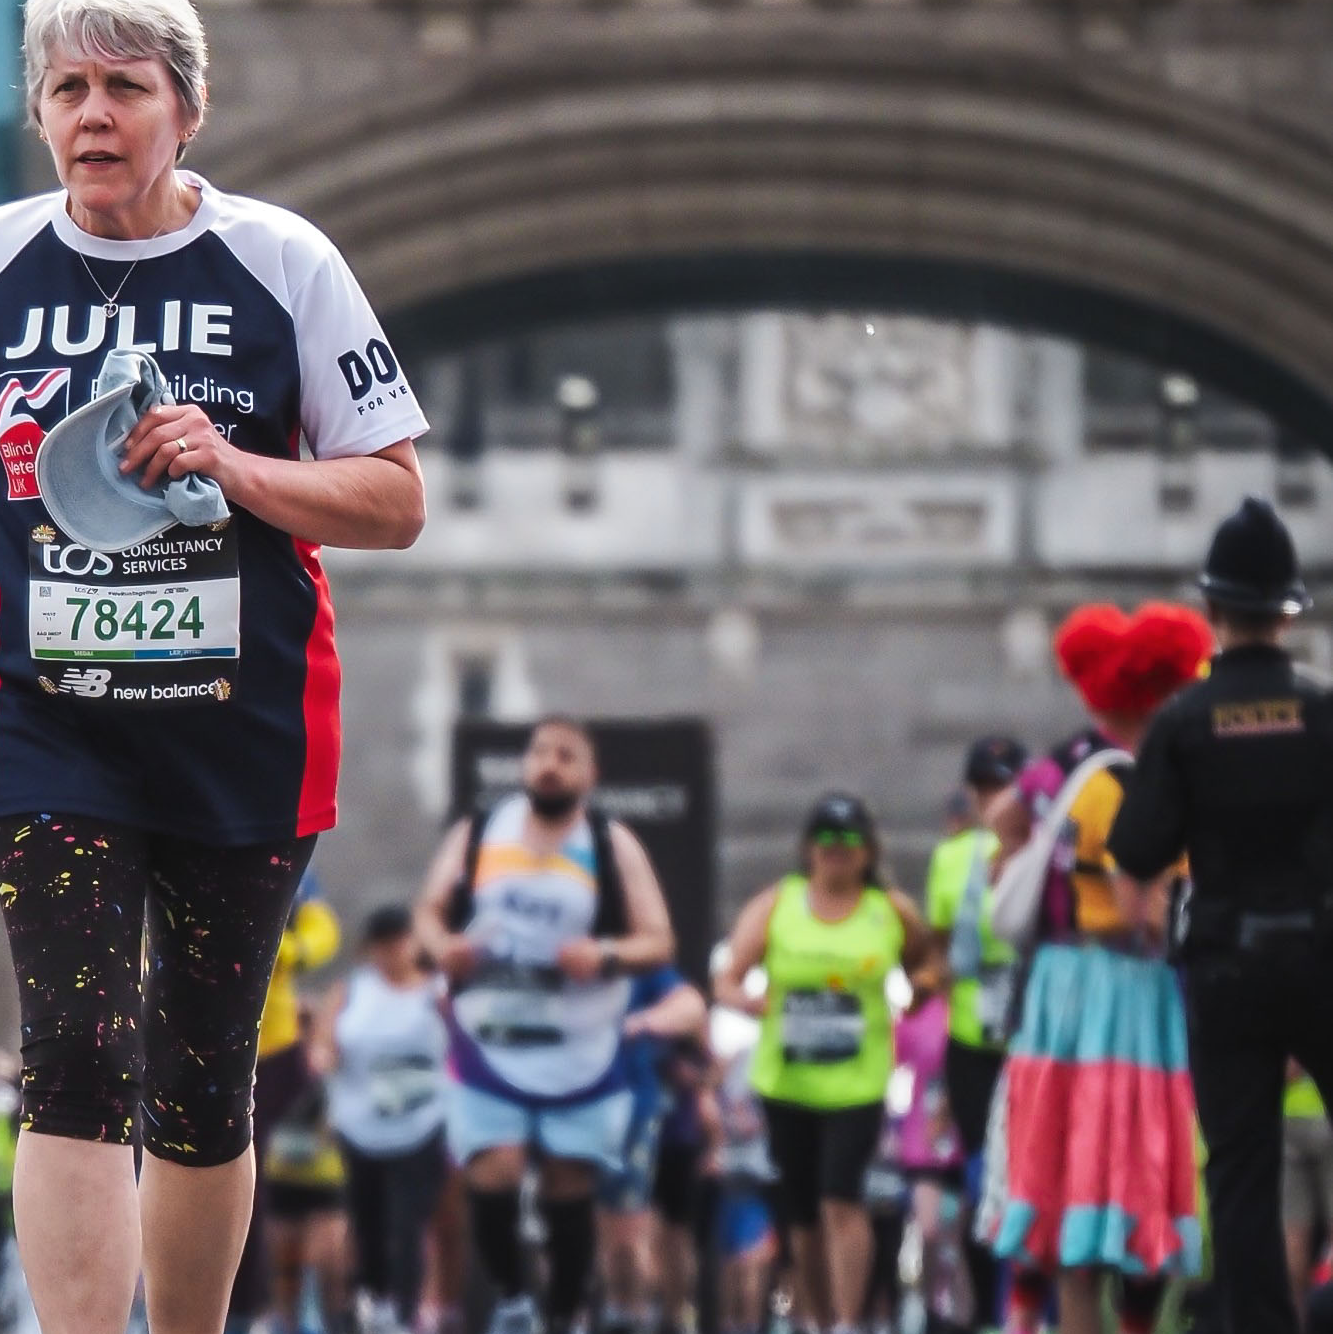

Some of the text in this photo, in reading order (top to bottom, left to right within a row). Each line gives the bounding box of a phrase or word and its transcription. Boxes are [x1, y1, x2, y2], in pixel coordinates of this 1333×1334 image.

[5, 299, 232, 359] JULIE
[356, 396, 384, 416] FOR
[1, 438, 34, 458] Blind
[6, 460, 35, 475] Vete
[11, 477, 27, 493] UK
[121, 537, 223, 559] CONSULTANCY
[122, 557, 188, 575] SERVICES
[66, 595, 205, 642] 78424
[113, 679, 217, 700] new balance
